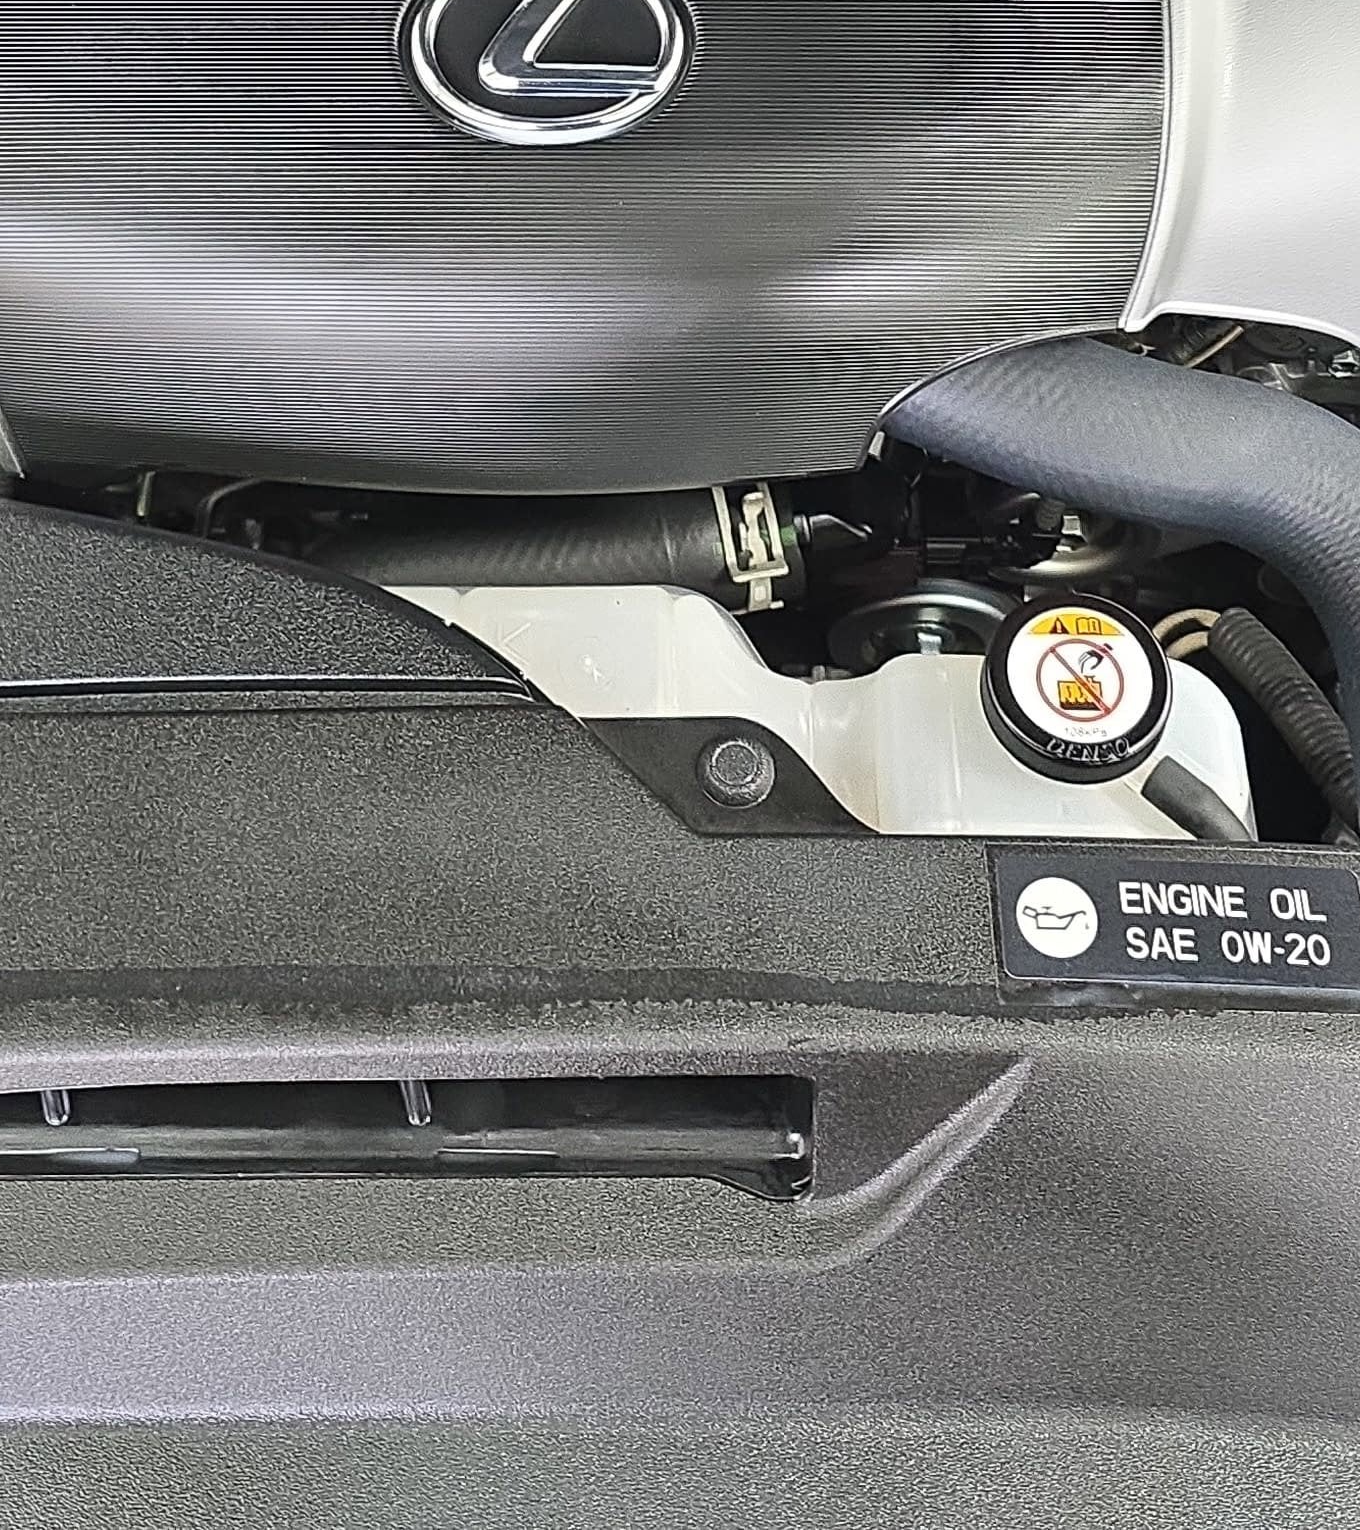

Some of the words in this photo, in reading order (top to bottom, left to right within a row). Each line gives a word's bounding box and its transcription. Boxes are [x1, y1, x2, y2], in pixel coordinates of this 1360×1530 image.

[1118, 881, 1248, 919] ENGINE
[1269, 887, 1328, 922] OIL
[1125, 926, 1199, 962] SAE
[1220, 929, 1332, 967] 0W-20
